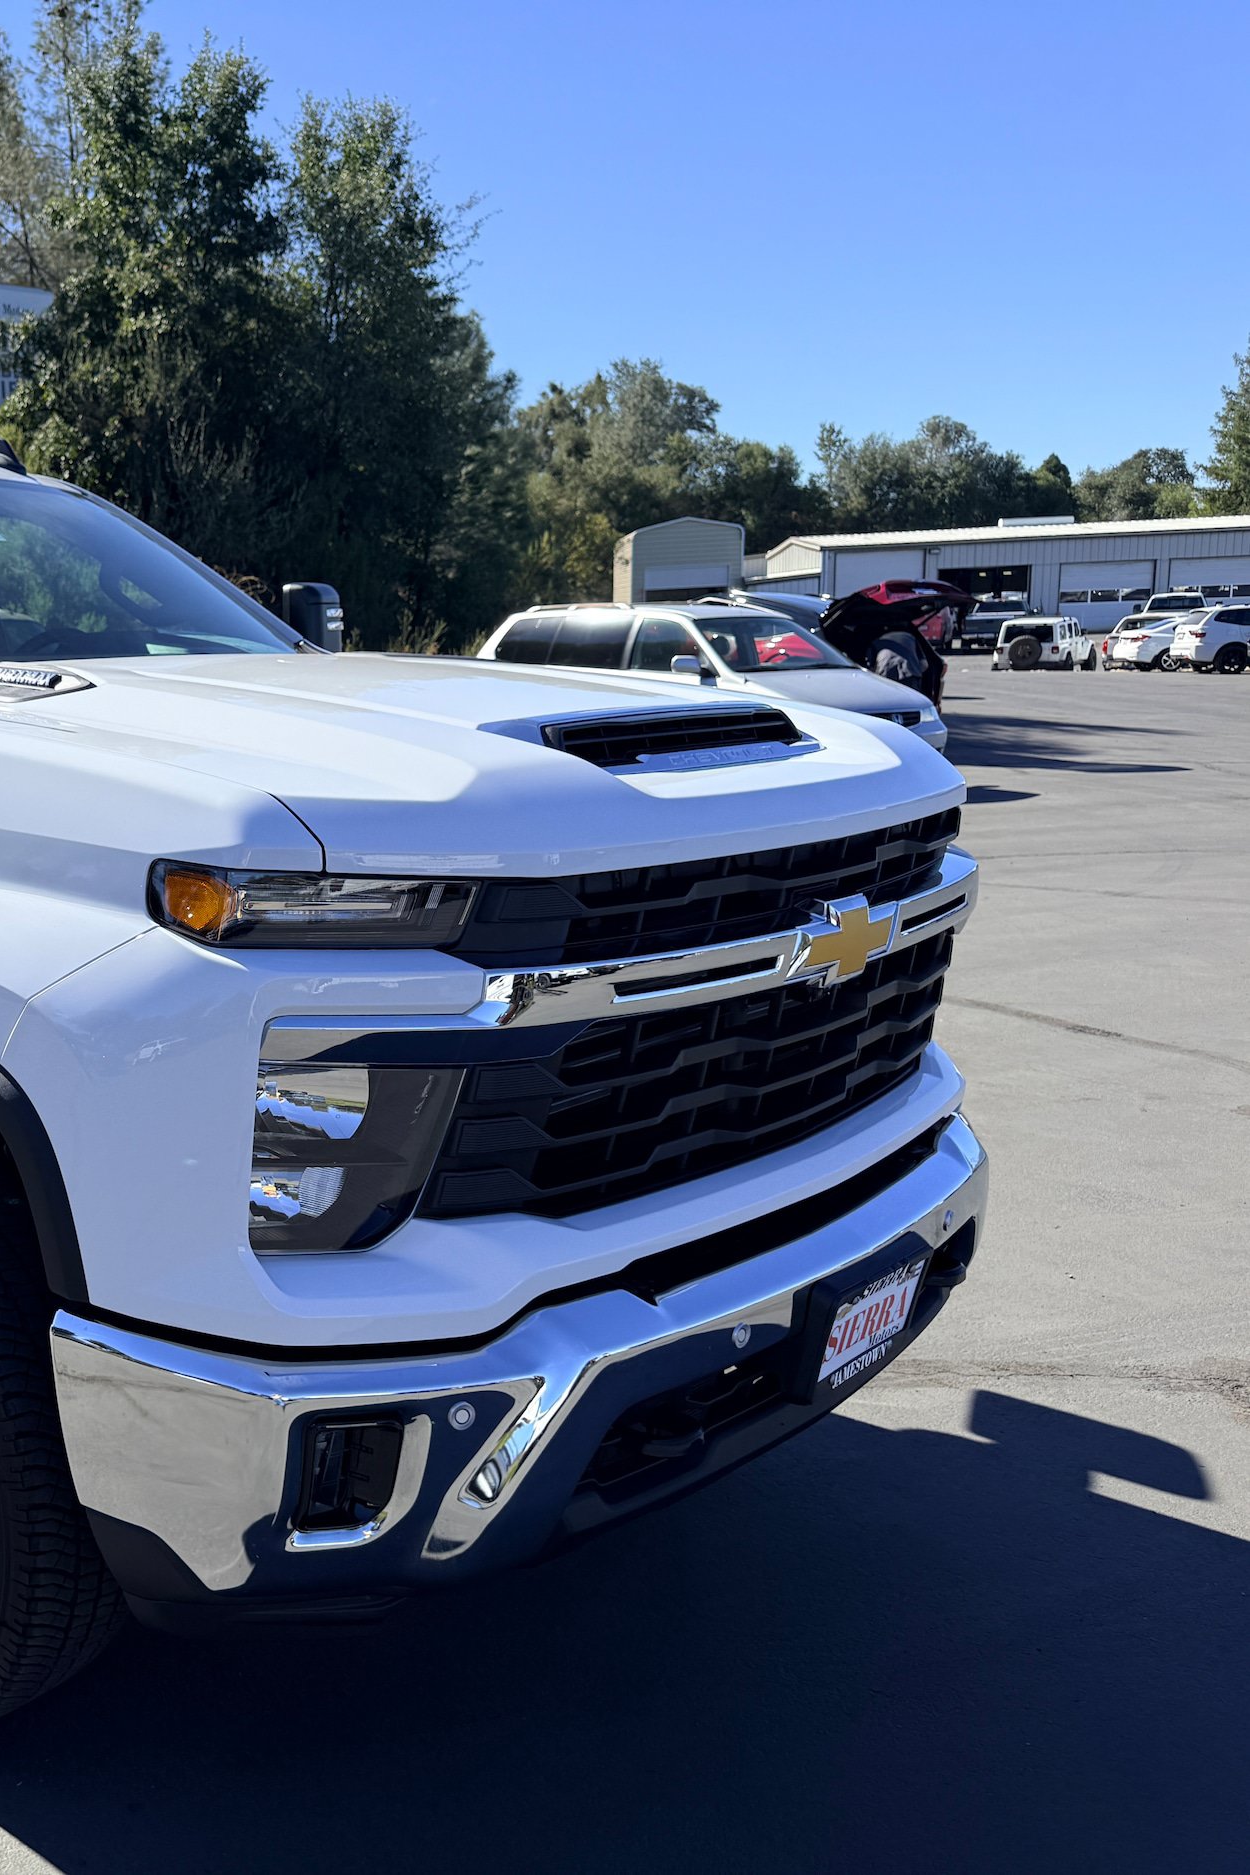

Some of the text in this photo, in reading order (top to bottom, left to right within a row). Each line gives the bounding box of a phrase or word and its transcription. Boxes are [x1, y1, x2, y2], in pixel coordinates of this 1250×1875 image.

[863, 1263, 910, 1298] SIERRA
[822, 1286, 908, 1364] SIERRA
[866, 1324, 900, 1350] Motors
[832, 1341, 888, 1389] JAMESTOWN
